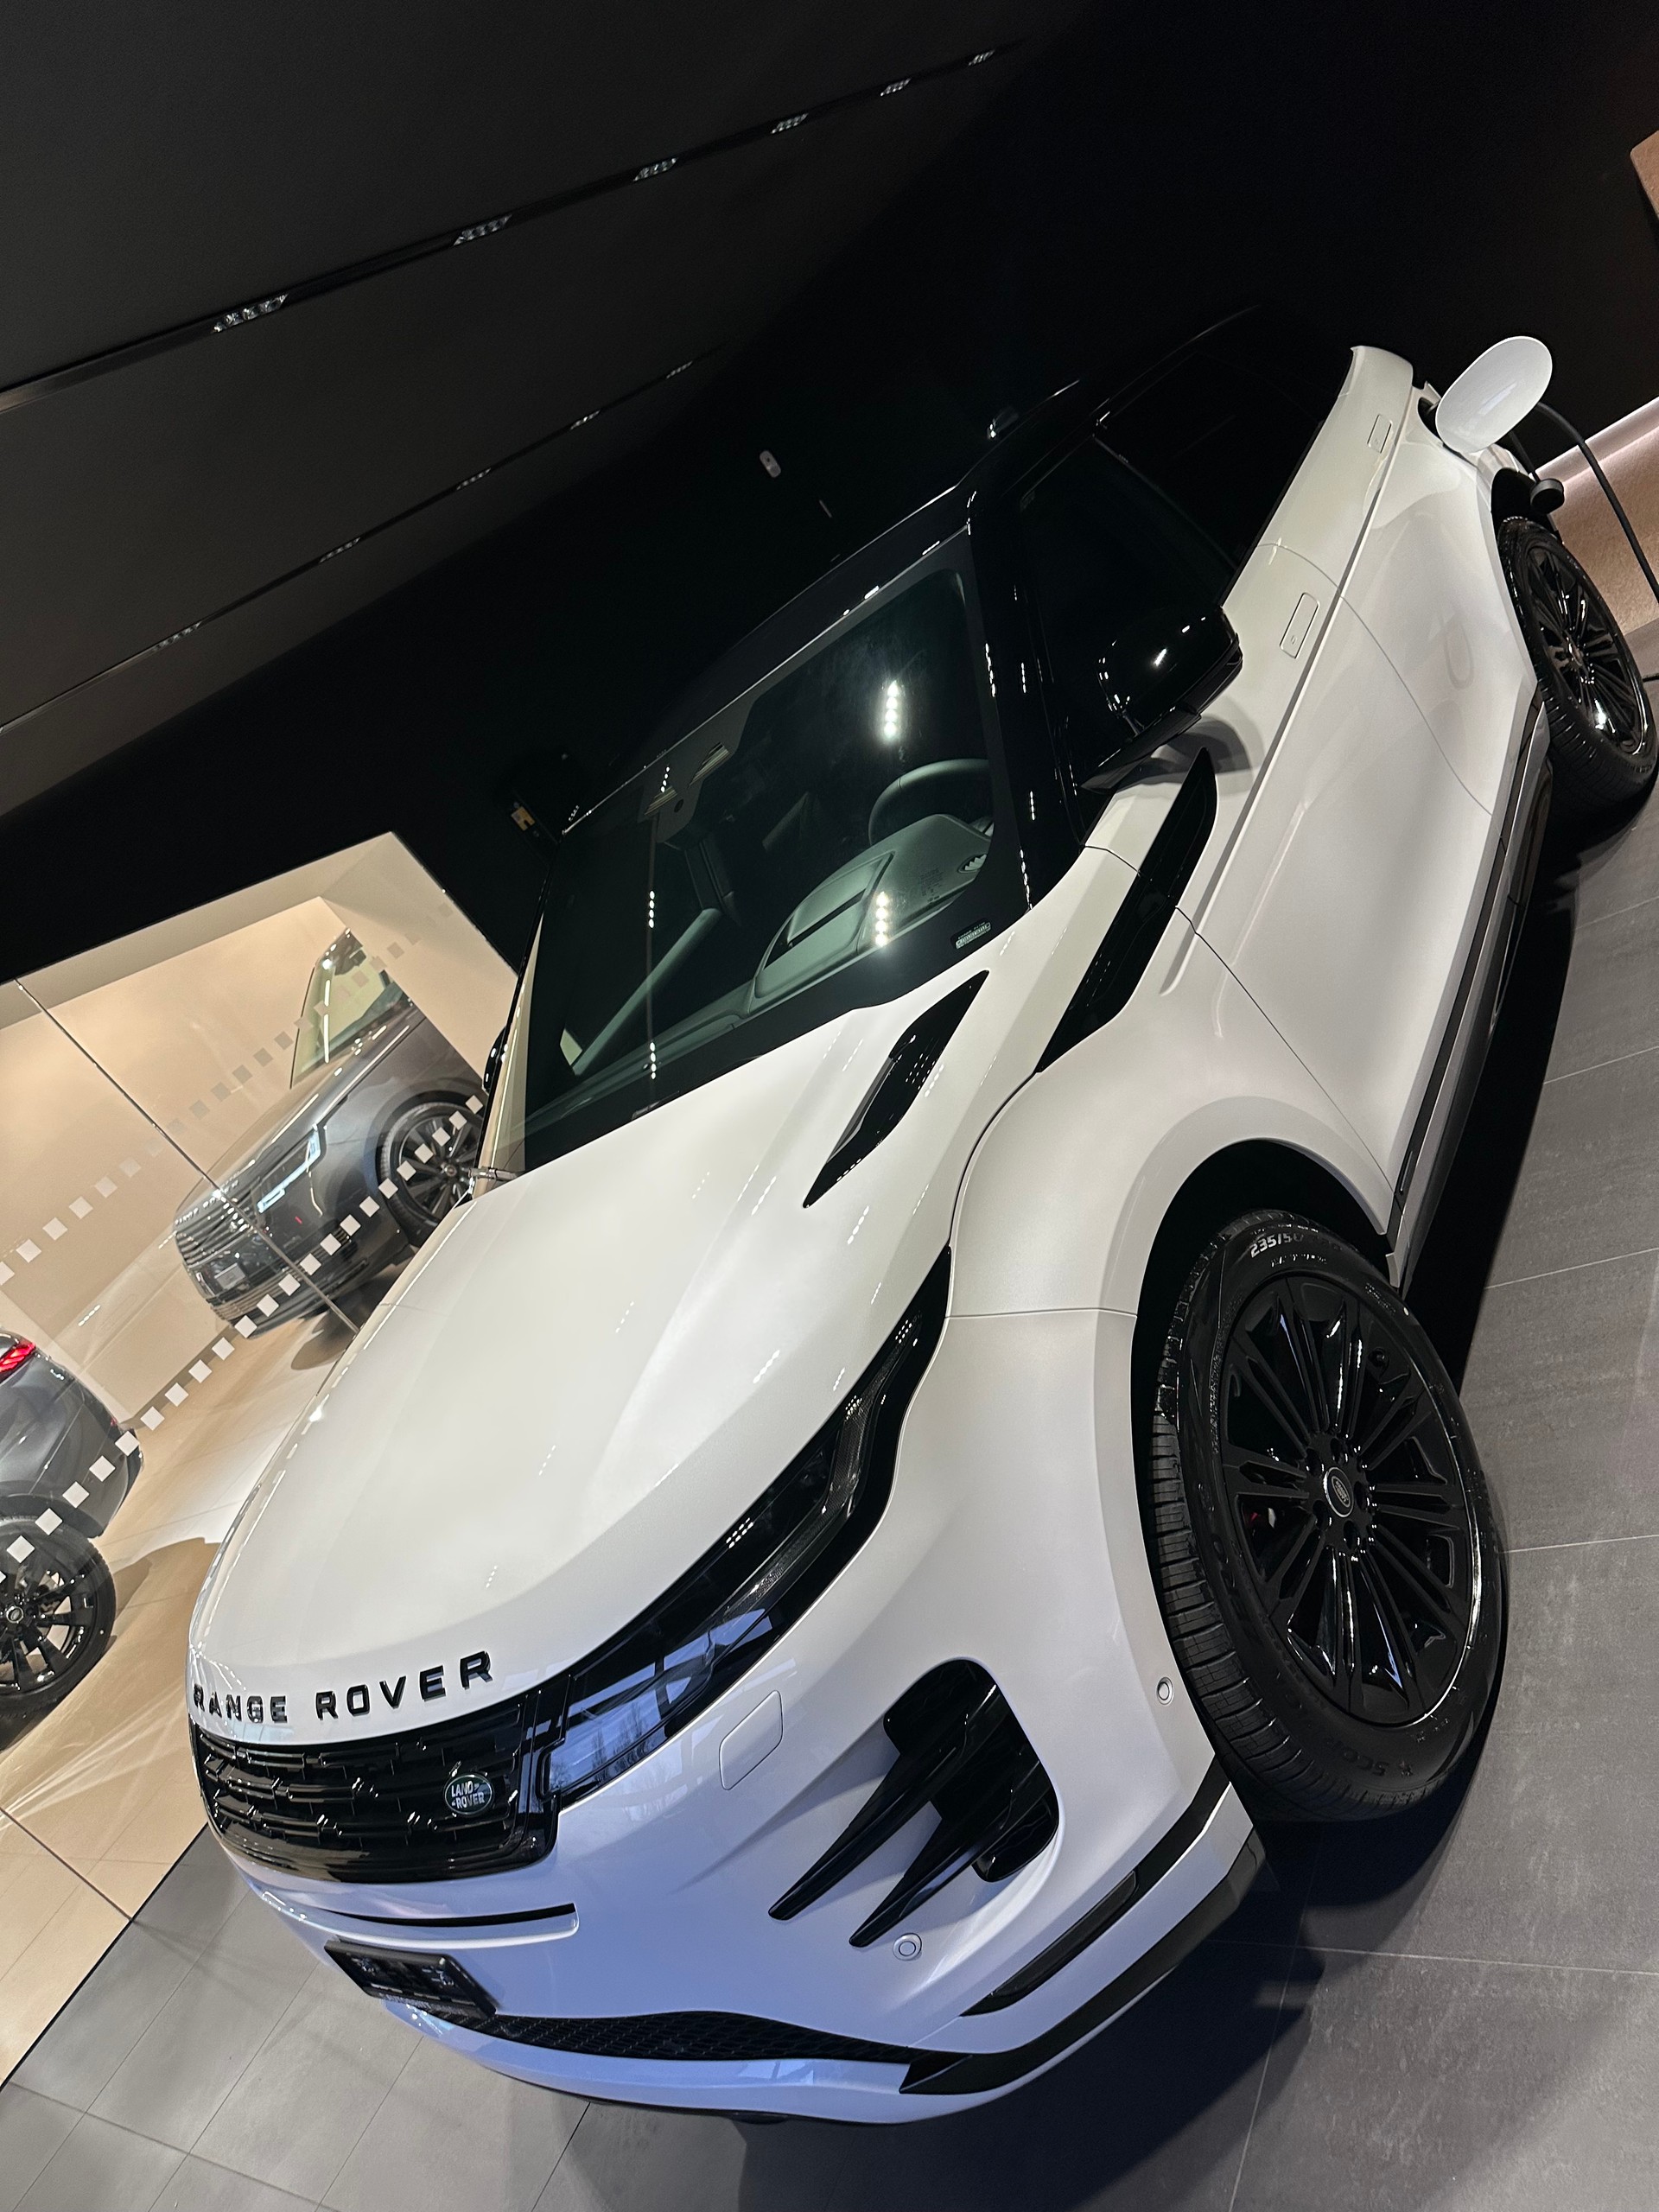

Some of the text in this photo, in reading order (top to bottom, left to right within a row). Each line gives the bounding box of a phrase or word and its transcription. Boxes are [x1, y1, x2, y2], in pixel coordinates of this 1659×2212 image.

[193, 1650, 493, 1723] RANGE ROVER
[451, 1781, 474, 1797] LAND
[455, 1791, 486, 1808] ROVER
